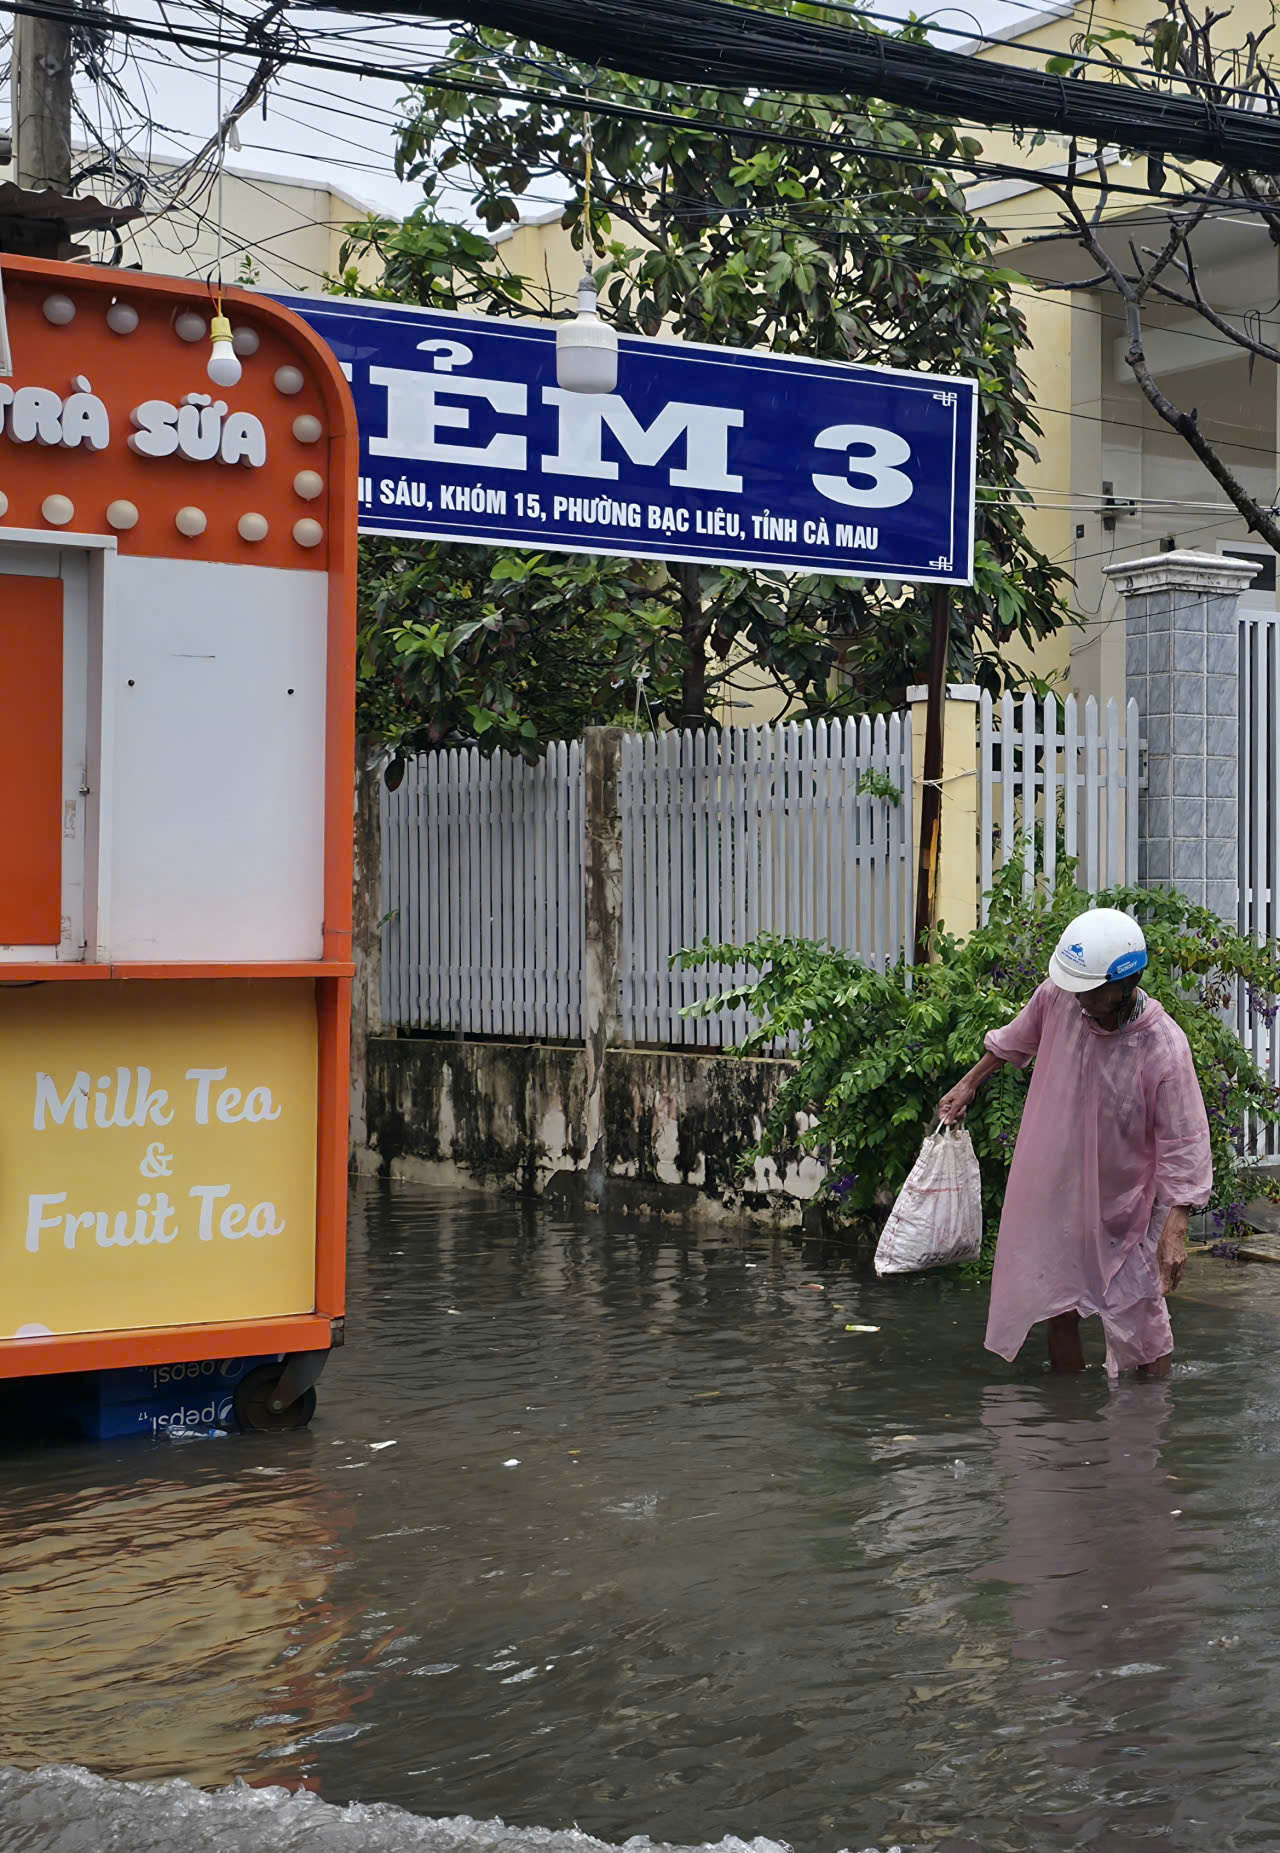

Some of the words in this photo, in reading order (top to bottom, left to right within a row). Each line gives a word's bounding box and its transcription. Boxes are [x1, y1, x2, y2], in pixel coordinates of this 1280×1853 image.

[128, 392, 267, 468] SỮA
[341, 339, 743, 493] ẺM
[812, 424, 914, 508] 3
[380, 475, 433, 512] SÁU,
[440, 483, 507, 516] KHÓM
[514, 492, 547, 522] 15,
[553, 494, 642, 529] PHƯỜNG
[648, 505, 690, 536] BẠC
[696, 507, 746, 540] LIÊU,
[751, 508, 798, 543] TỈNH
[803, 517, 830, 546] CÀ
[835, 523, 879, 550] MAU
[33, 1065, 175, 1131] Milk
[185, 1066, 282, 1125] Tea
[139, 1142, 174, 1178] &
[25, 1192, 179, 1253] Fruit
[188, 1183, 286, 1241] Tea
